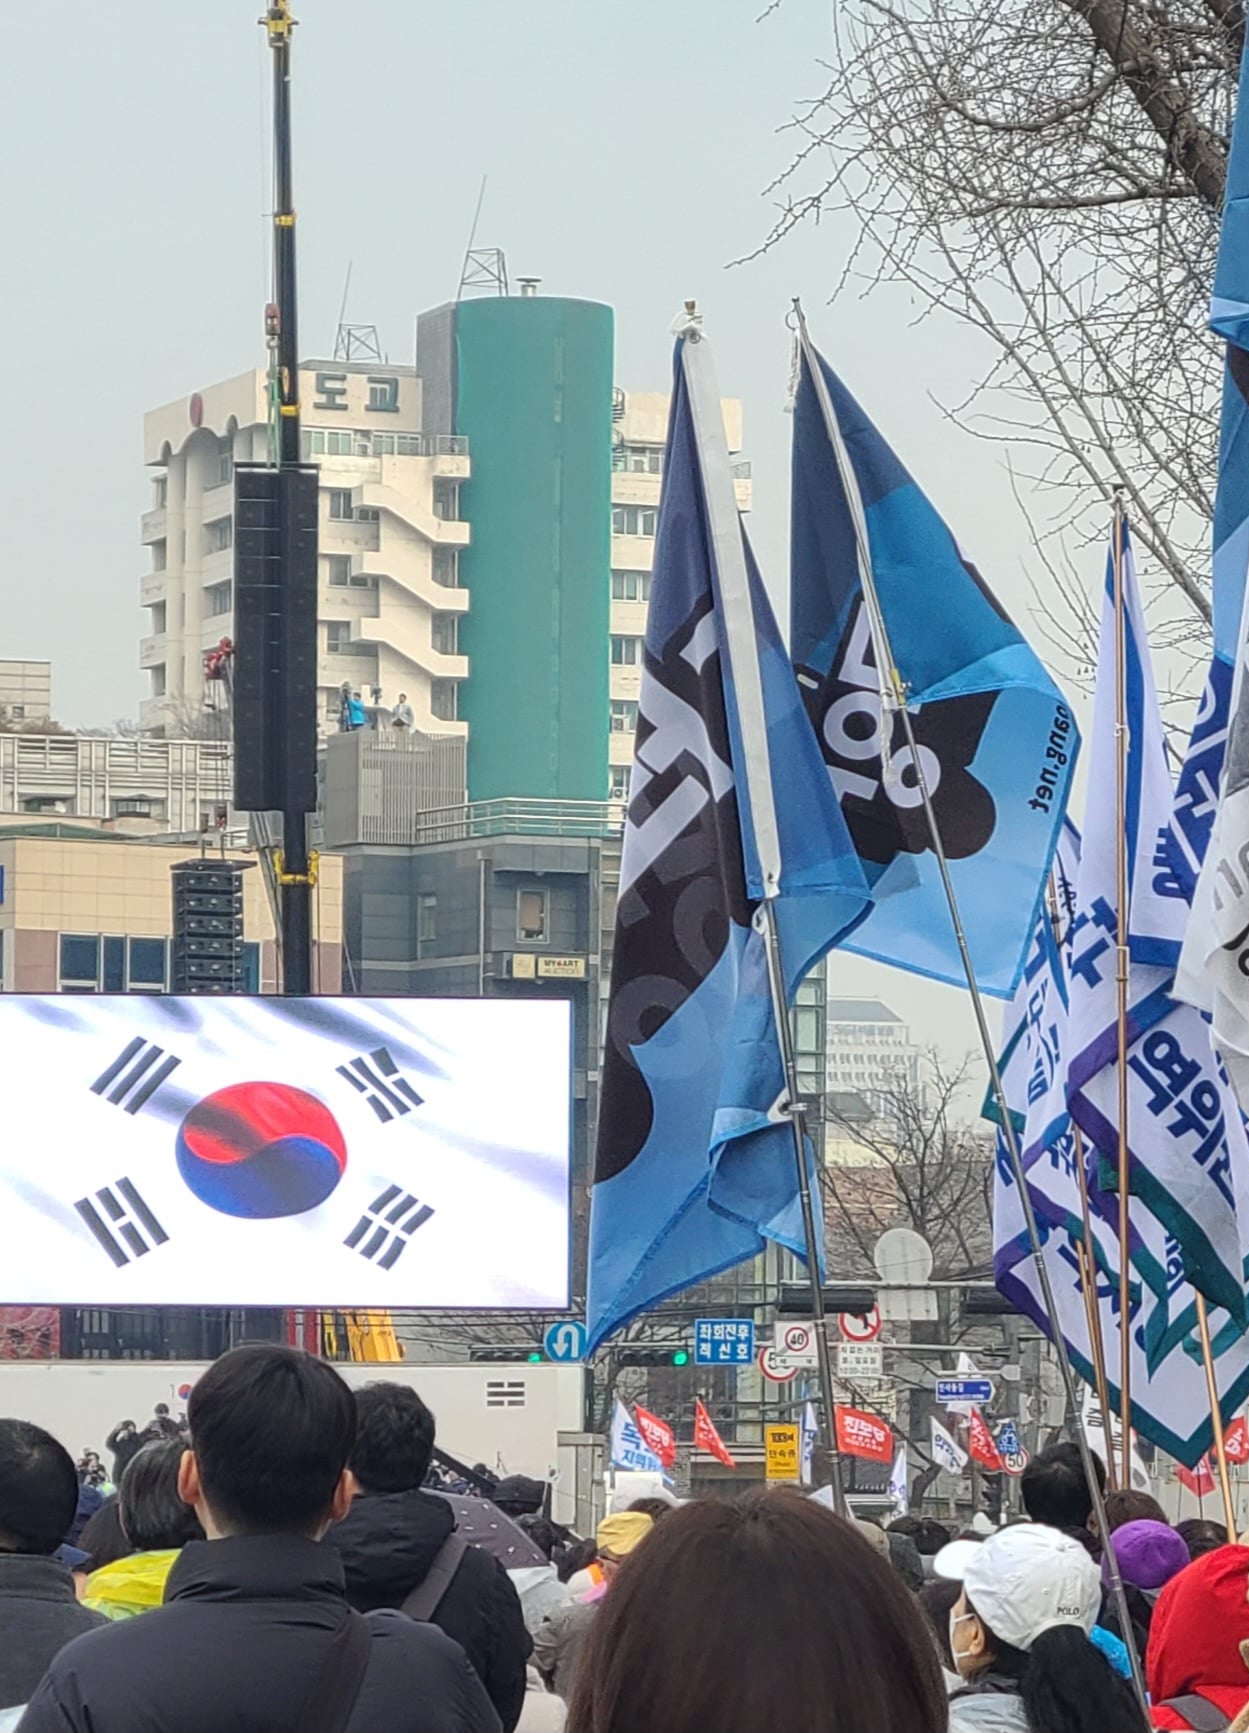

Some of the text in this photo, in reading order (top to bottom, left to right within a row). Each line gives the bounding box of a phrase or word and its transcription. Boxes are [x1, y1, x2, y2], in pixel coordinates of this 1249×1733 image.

[313, 372, 400, 413] 도교
[790, 1333, 804, 1345] 40
[843, 1415, 886, 1442] 진보당
[1008, 1454, 1024, 1468] 50
[1056, 1606, 1080, 1616] POLO
